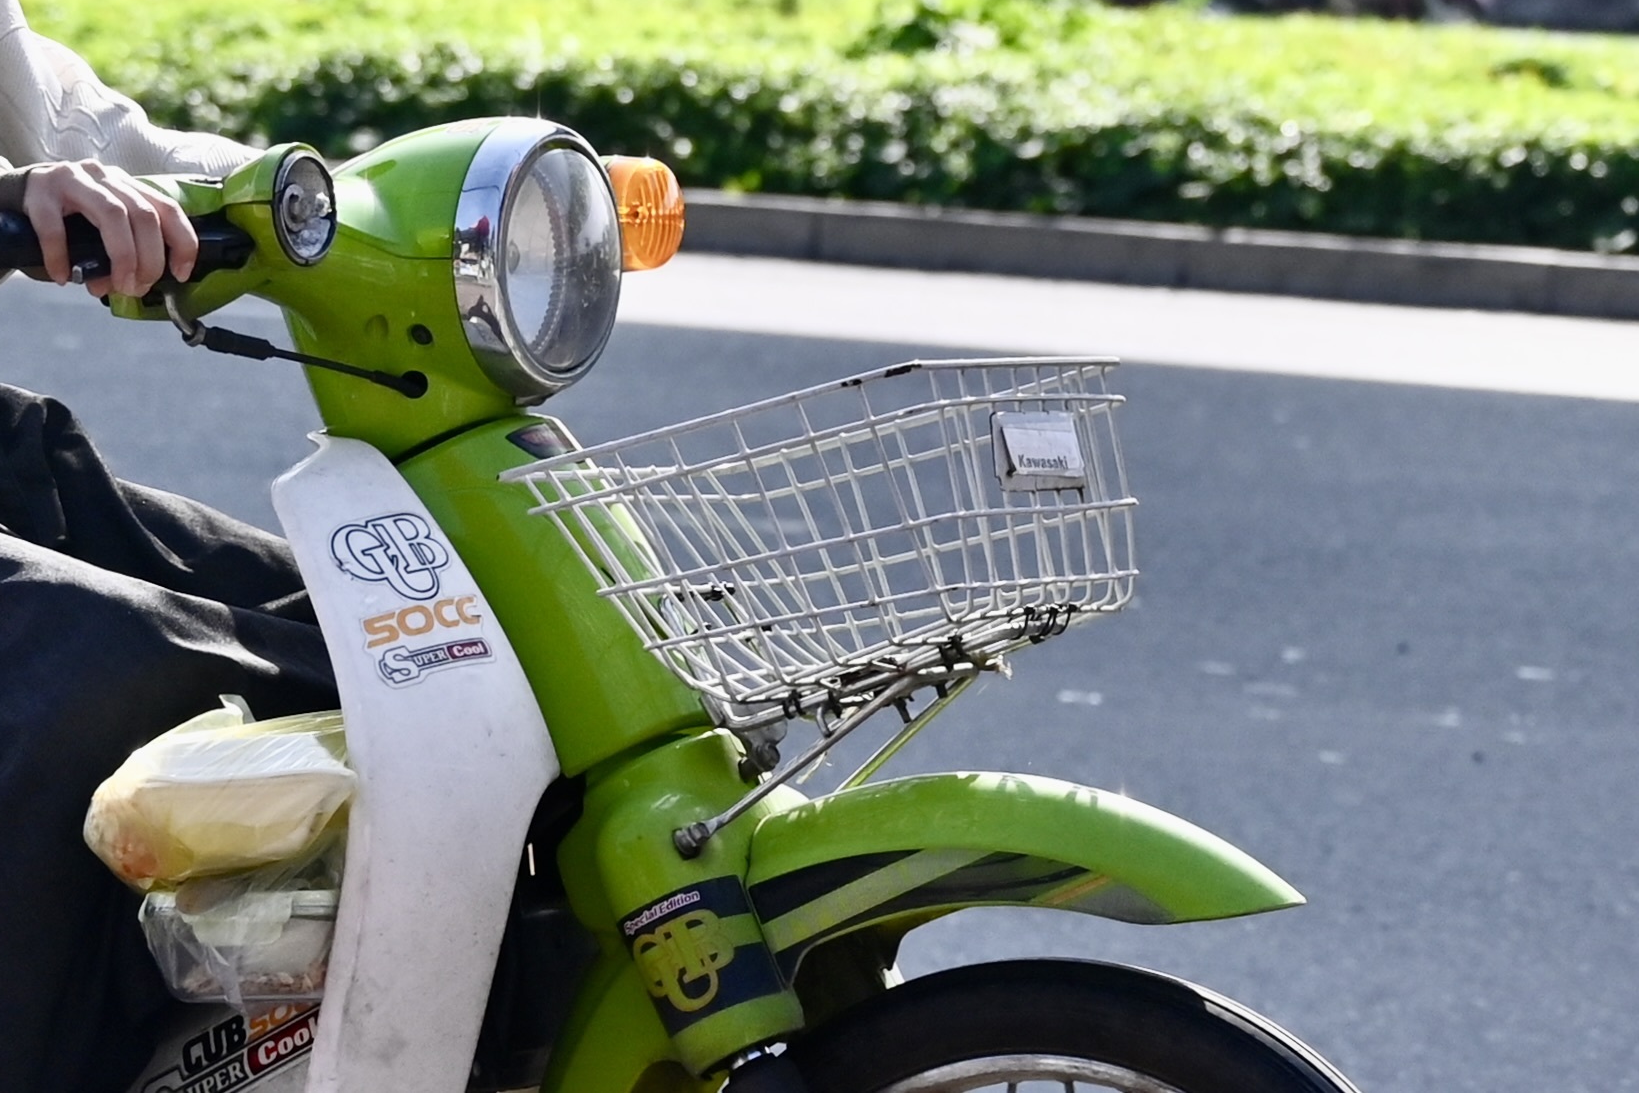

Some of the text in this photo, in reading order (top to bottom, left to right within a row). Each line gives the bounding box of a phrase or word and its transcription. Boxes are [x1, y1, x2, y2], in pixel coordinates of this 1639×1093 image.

[1017, 454, 1069, 470] Kawasaki
[451, 642, 486, 658] Cool
[624, 891, 700, 936] Special Edition
[182, 1014, 247, 1076] CUB
